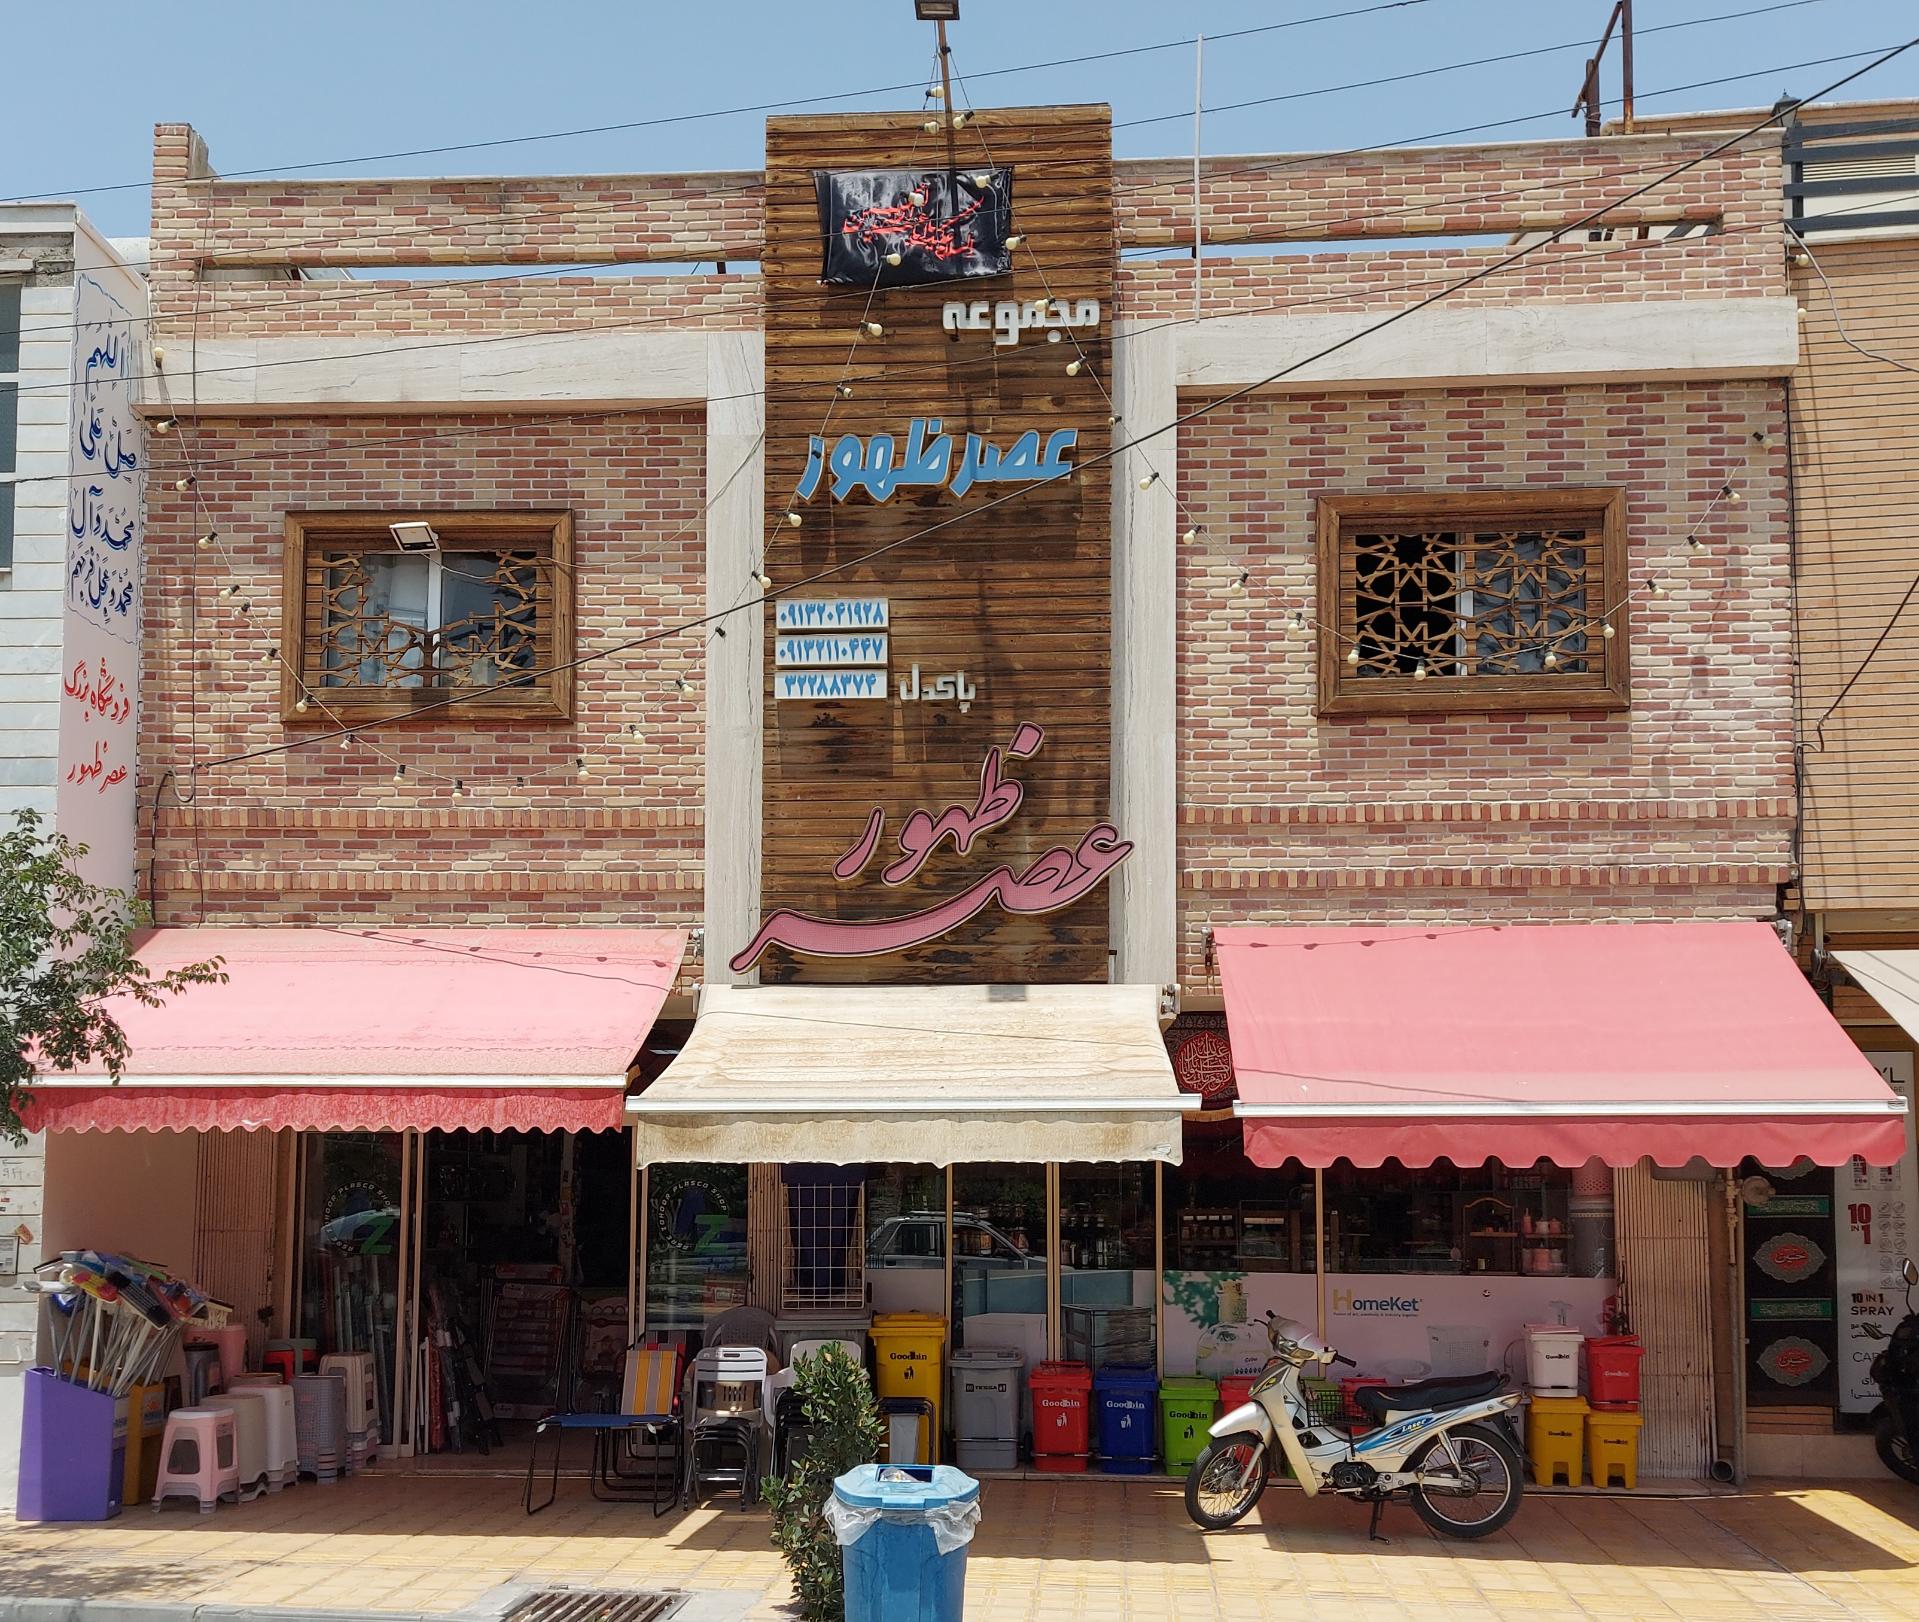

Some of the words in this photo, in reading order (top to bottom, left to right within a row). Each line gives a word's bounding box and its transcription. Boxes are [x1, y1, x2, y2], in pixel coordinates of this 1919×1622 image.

[942, 298, 1100, 345] مجموعه
[796, 417, 953, 503] ظهور
[949, 427, 1079, 498] عصر
[780, 601, 884, 626] ۰۹۱۳۲۰۴۱۹۲۸
[779, 637, 883, 662] ۰۹۱۳۲۱۱۰۴۴۷
[64, 659, 90, 721] بزرگ
[784, 673, 877, 696] ۳۲۲۸۸۳۷۴
[66, 740, 108, 786] ظهور
[98, 764, 128, 794] عصر
[832, 721, 1046, 886] ظهور
[729, 822, 1136, 975] عصر
[1847, 1203, 1872, 1225] 10
[1861, 1224, 1872, 1245] 1
[1333, 1288, 1420, 1312] HomeKet
[1850, 1306, 1895, 1316] SPRAY
[1851, 1293, 1864, 1304] 10
[1865, 1294, 1876, 1303] IN
[1877, 1293, 1884, 1303] 1
[1401, 1417, 1427, 1433] Laser
